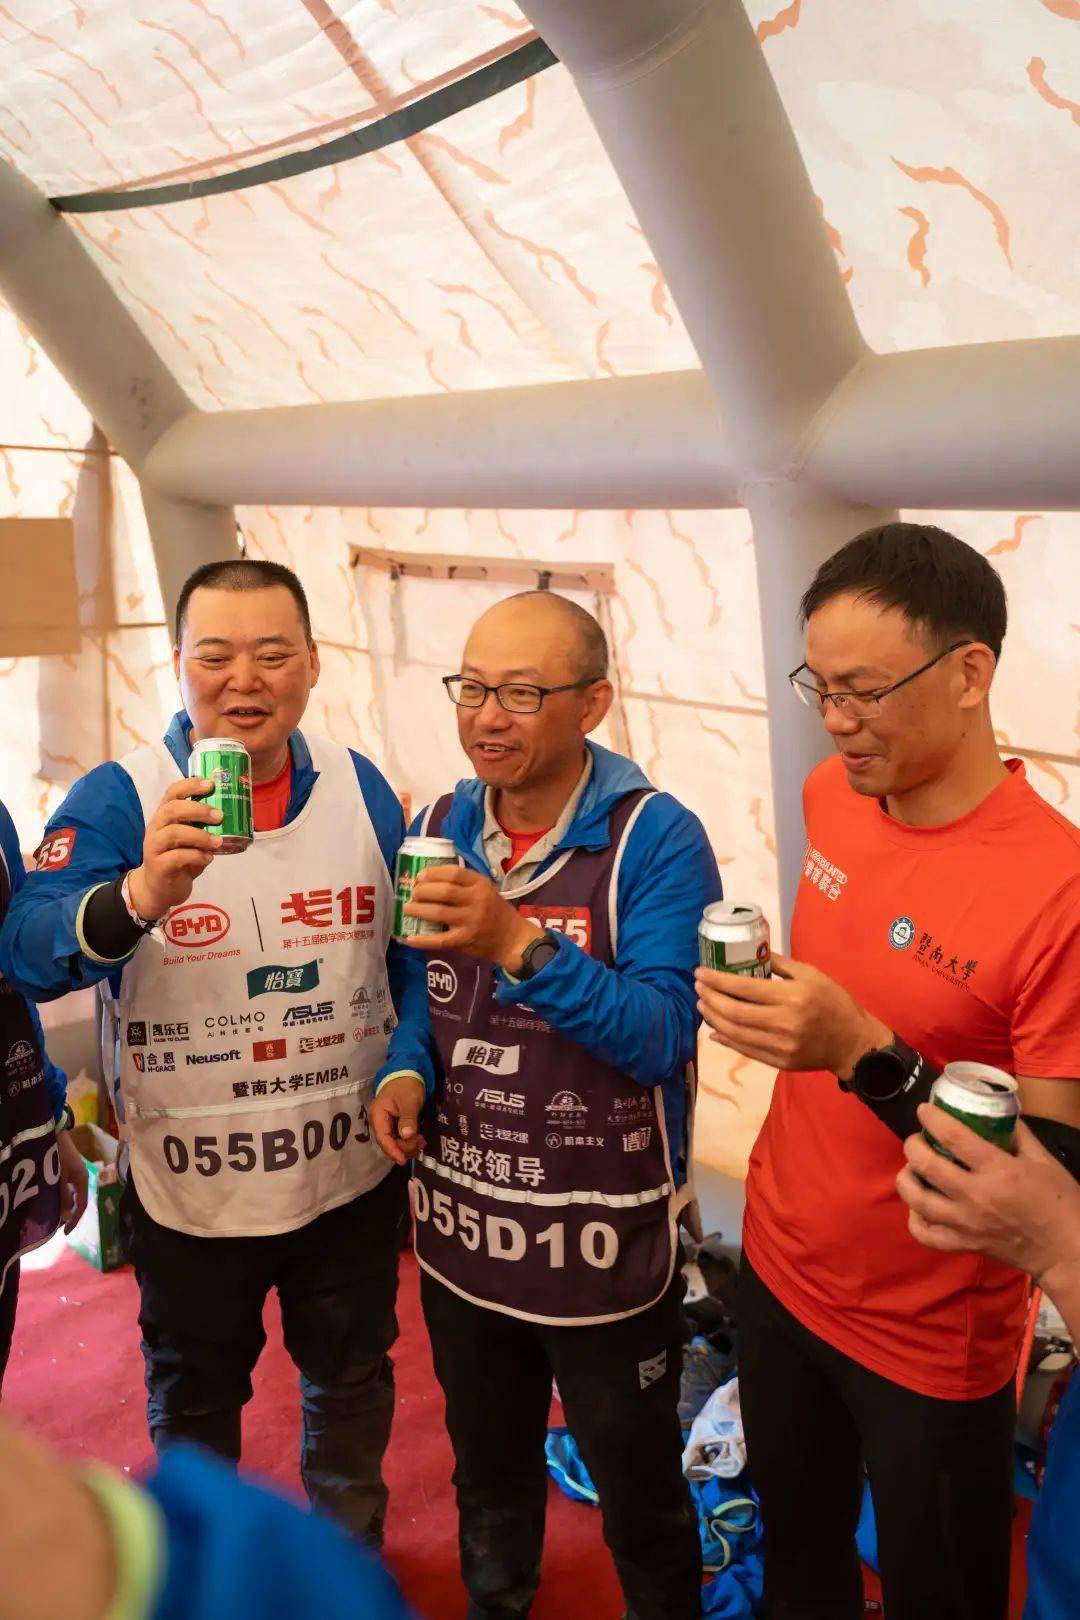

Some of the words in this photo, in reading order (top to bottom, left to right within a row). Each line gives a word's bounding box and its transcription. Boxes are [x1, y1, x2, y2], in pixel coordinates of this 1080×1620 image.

[170, 914, 223, 937] BYD
[163, 956, 184, 966] Build
[186, 953, 206, 963] Your
[207, 948, 241, 960] Dreams
[204, 1011, 265, 1028] COLMO
[282, 1001, 334, 1022] ASUS
[185, 1049, 241, 1065] Neusoft
[147, 1065, 176, 1073] H-GRACE
[232, 1065, 349, 1098] 暨南大学EMBA
[475, 1088, 525, 1108] ASUS
[439, 1134, 546, 1187] 院校领导
[413, 1177, 620, 1269] 055D10
